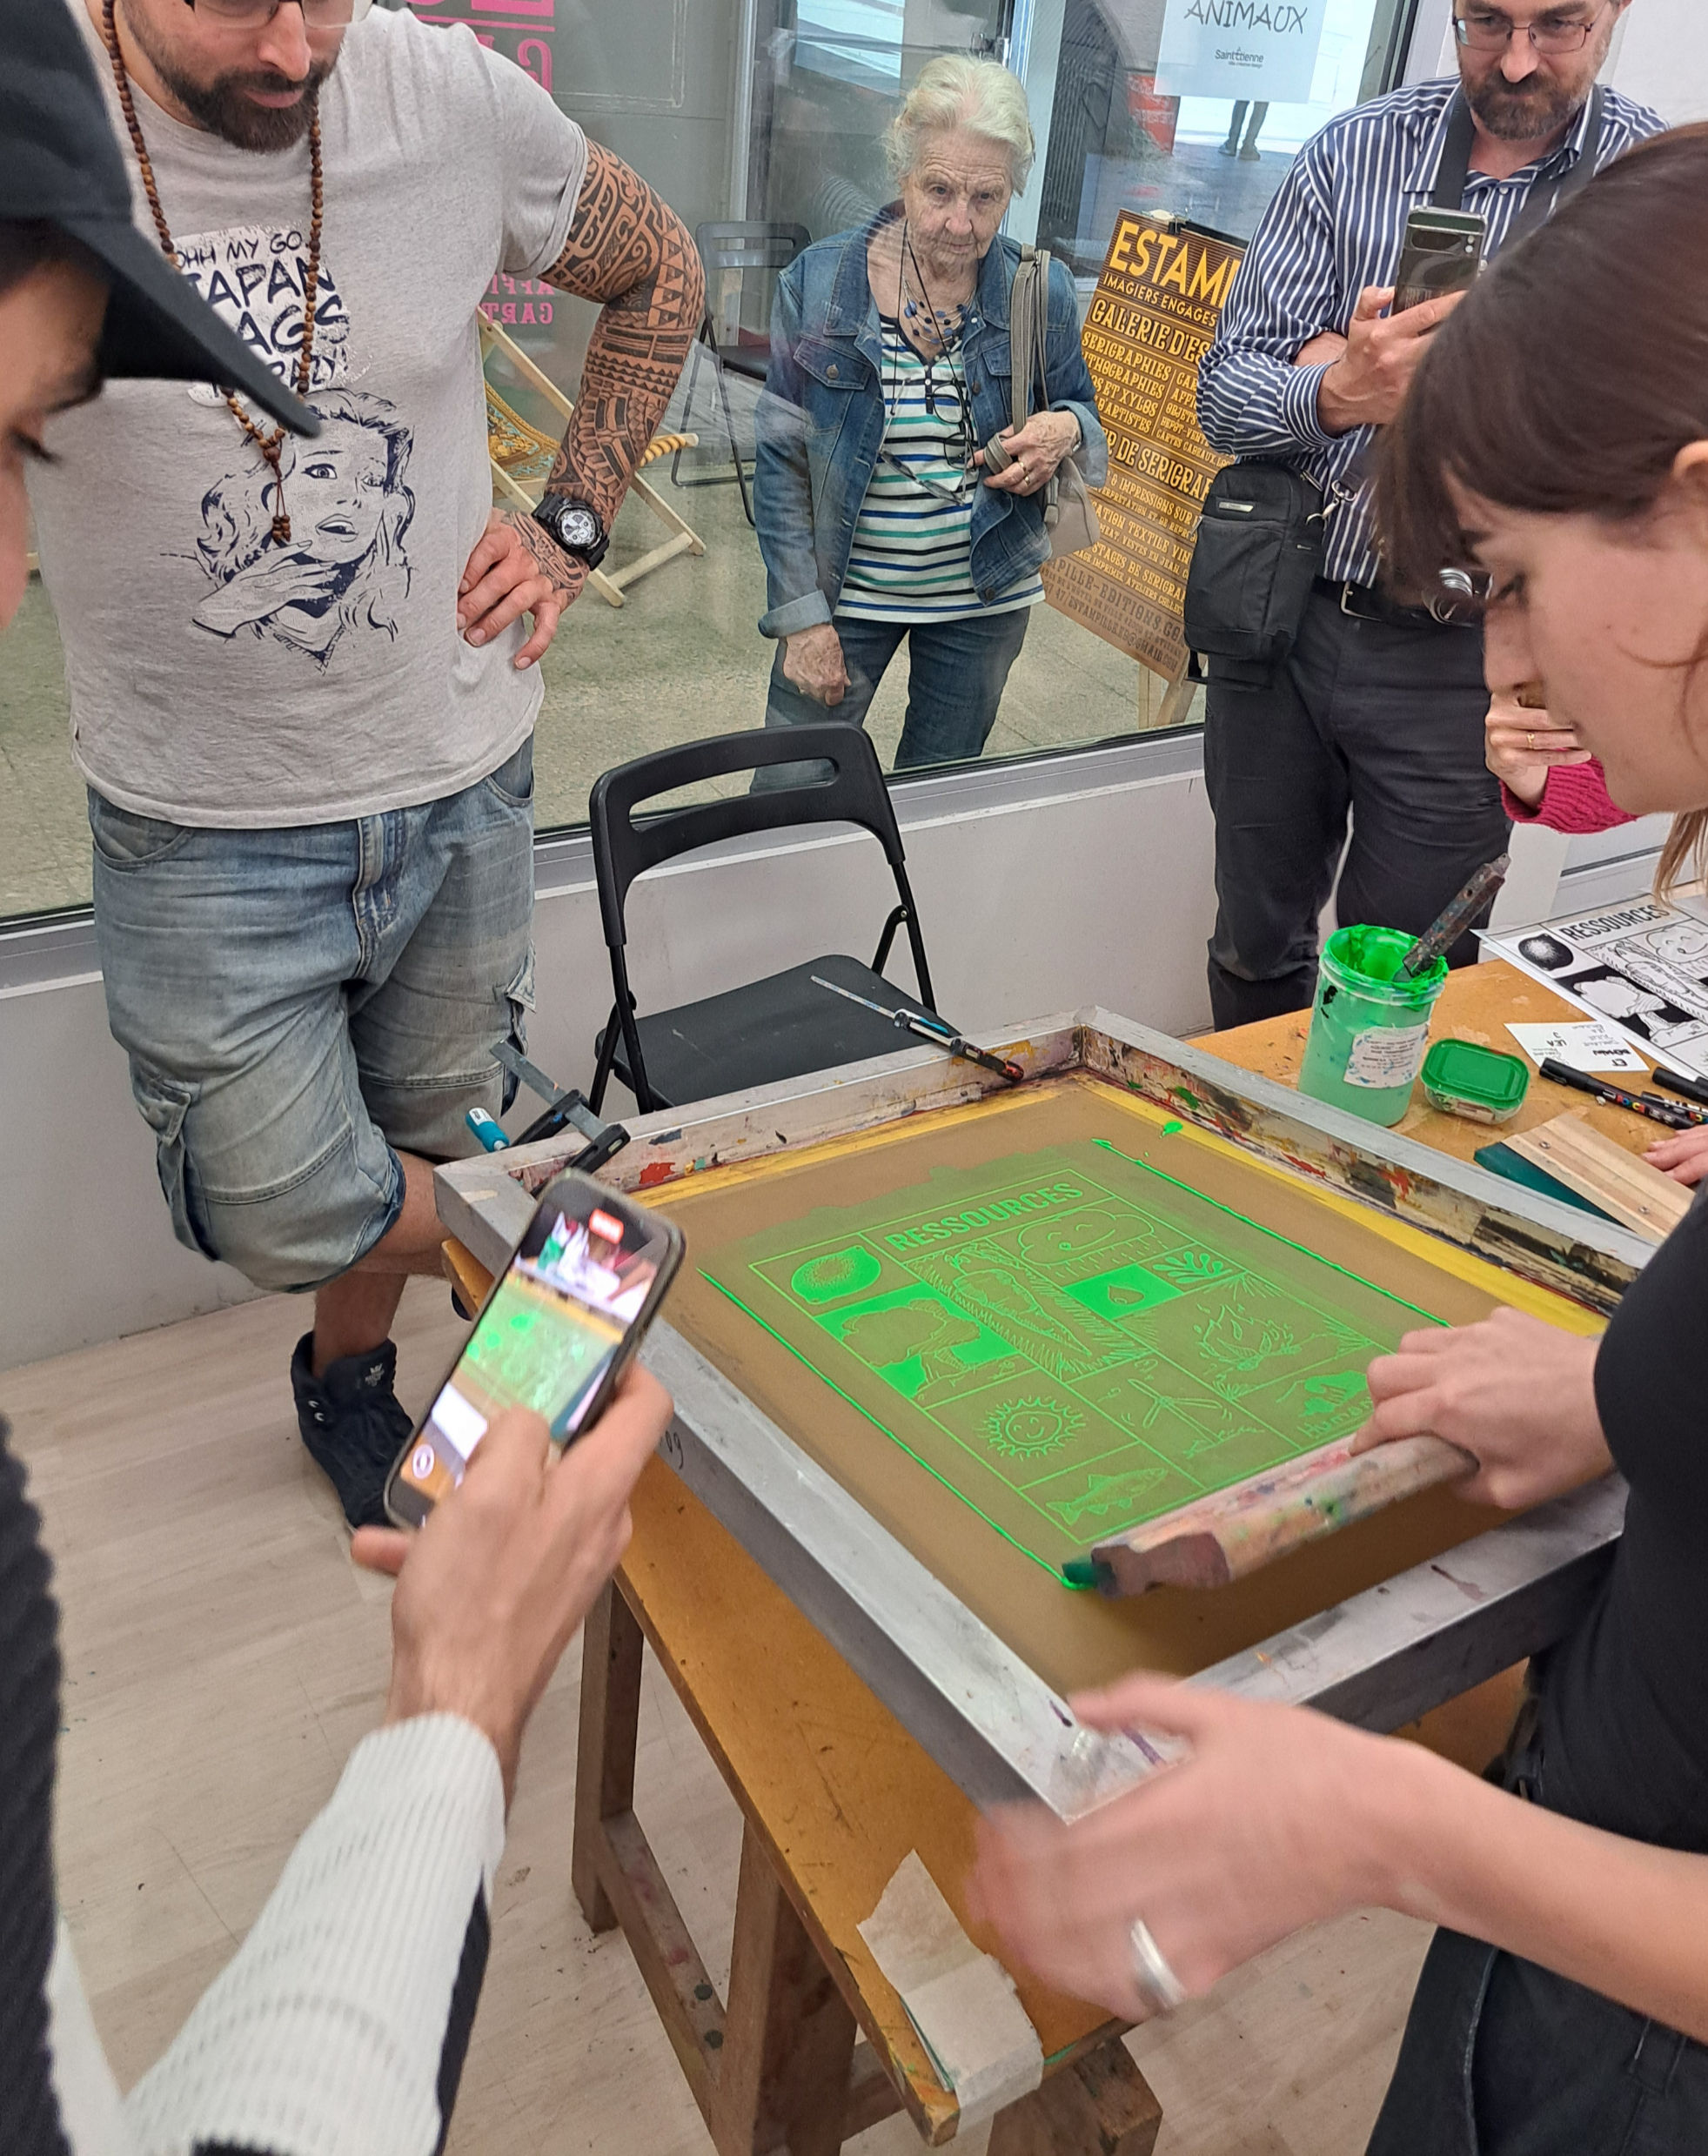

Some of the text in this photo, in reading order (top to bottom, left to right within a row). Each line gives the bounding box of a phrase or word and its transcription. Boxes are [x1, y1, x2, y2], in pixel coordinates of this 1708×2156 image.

[1183, 0, 1308, 34] ANIMAUX
[226, 238, 259, 262] MY
[270, 231, 310, 254] GO
[1102, 272, 1218, 327] IMAGIERS ENGAGES
[237, 294, 351, 355] AGS
[1091, 298, 1171, 351] GALERIE
[1082, 331, 1172, 382] SERIGRAPHIES
[1082, 351, 1165, 399] ITHOGRAPHIES
[1102, 380, 1121, 398] ET
[1119, 388, 1159, 418] XYLOS
[1115, 436, 1140, 466] DE
[1119, 478, 1175, 515] IMPRESSIONS
[1173, 506, 1193, 526] SUR
[1128, 520, 1170, 553] TEXTILE
[1091, 540, 1128, 569] STAGES
[1128, 559, 1142, 578] DE
[1558, 904, 1671, 941] RESSOURCES
[884, 1182, 1083, 1252] RESSOURCES
